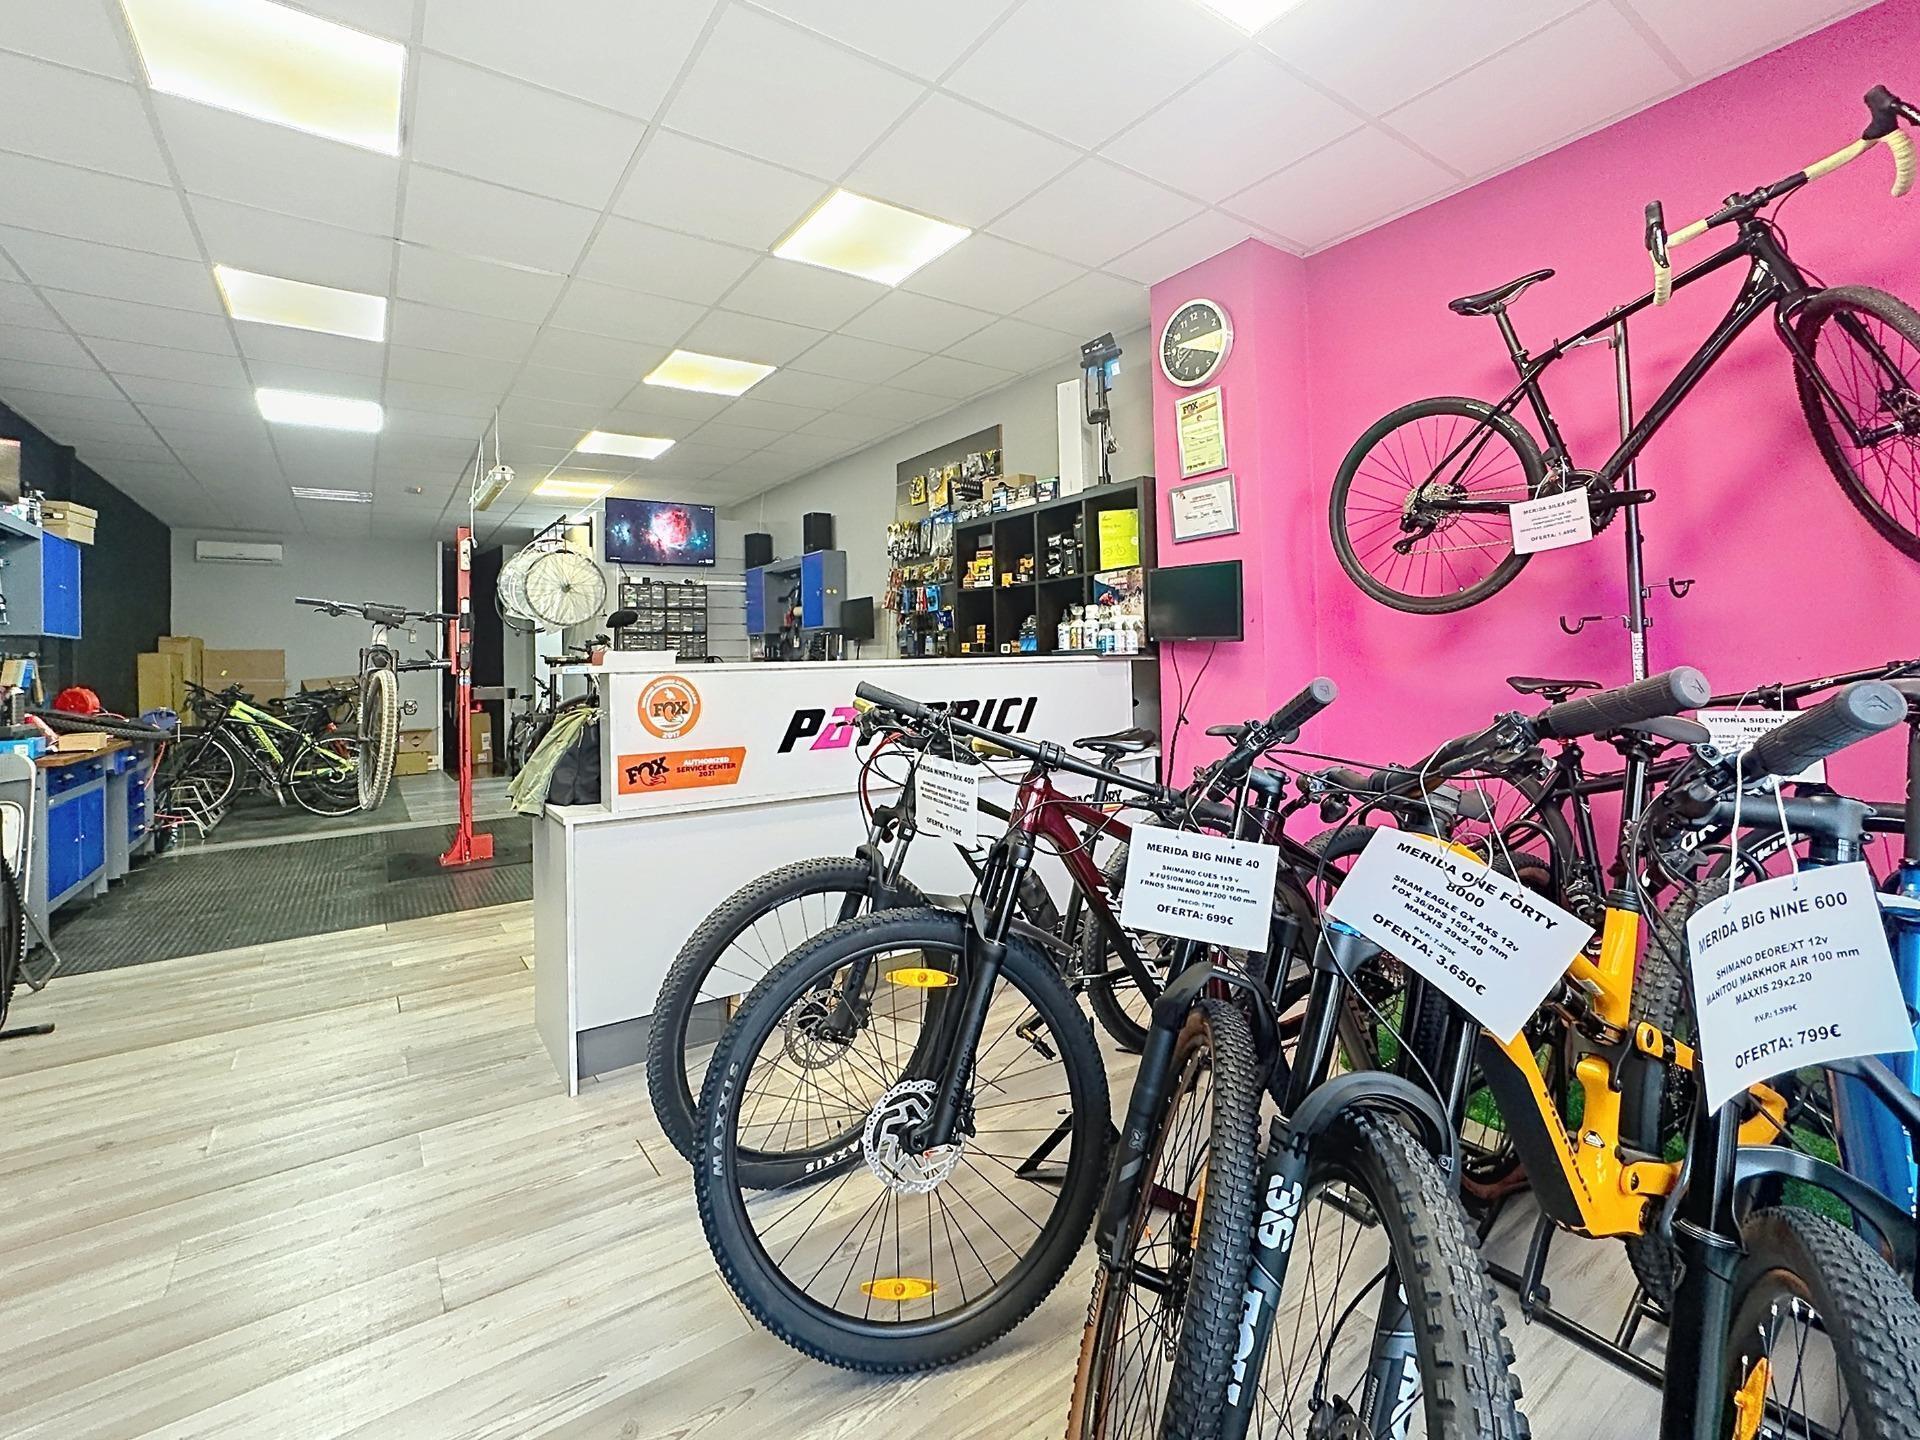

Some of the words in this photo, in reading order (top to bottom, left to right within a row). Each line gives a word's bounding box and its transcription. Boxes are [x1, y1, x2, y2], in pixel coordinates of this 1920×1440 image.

[1181, 320, 1188, 329] 11
[1190, 312, 1198, 321] 12
[1212, 318, 1216, 326] 2
[1173, 333, 1181, 341] 10
[1172, 348, 1176, 356] 9
[1176, 361, 1180, 369] 8
[1185, 367, 1189, 375] 7
[1207, 359, 1211, 367] 5
[1183, 401, 1198, 414] FOX
[1523, 506, 1547, 515] MERIDA
[653, 701, 689, 721] FOX
[626, 756, 670, 786] FOX
[677, 765, 707, 773] SERVICE
[708, 763, 736, 771] CENTER
[684, 757, 730, 766] AUTHORIZED
[919, 764, 933, 773] ERIDA
[1147, 843, 1189, 858] MERIDA
[1192, 851, 1212, 861] BIG
[1215, 854, 1242, 866] NINE
[1246, 859, 1260, 869] 40
[1162, 865, 1196, 876] SHIMANO
[1198, 871, 1218, 880] CUES
[1167, 885, 1200, 895] SHIMANO
[1202, 890, 1227, 900] MT200
[1186, 878, 1205, 887] MIGO
[1207, 882, 1220, 890] AIR
[1397, 842, 1457, 875] MERIDA
[1461, 872, 1498, 895] ONE
[1500, 892, 1559, 930] FORTY
[1446, 882, 1485, 908] 8000
[1157, 904, 1204, 920] OFERTA:
[1207, 914, 1234, 925] 699€
[1392, 885, 1412, 899] FOX
[1413, 896, 1448, 920] 36/DPS
[1451, 918, 1488, 946] 150/140
[1489, 943, 1508, 960] mm
[1394, 875, 1423, 894] SRAM
[1425, 890, 1458, 912] EAGLE
[1460, 911, 1475, 924] GX
[1476, 921, 1499, 939] AXS
[1501, 937, 1520, 953] 12v
[1698, 922, 1739, 954] MERIDA
[1741, 911, 1765, 930] BIG
[1770, 899, 1810, 920] NINE
[1815, 892, 1848, 910] 600
[1404, 903, 1444, 930] MAXXIS
[1444, 927, 1484, 956] 29x2.40
[1372, 913, 1433, 958] OFERTA:
[1436, 955, 1487, 996] 3.650€
[1716, 956, 1753, 980] SHIMANO
[1808, 936, 1829, 946] 12v
[1706, 980, 1738, 1006] MANITOU
[1739, 962, 1787, 986] MARKHOR
[1790, 956, 1809, 969] AIR
[1812, 951, 1833, 963] 100
[1837, 948, 1860, 959] mm
[1735, 984, 1770, 1005] MAXXIS
[1771, 972, 1812, 991] 29x2.20
[1735, 1037, 1794, 1069] OFERTA:
[1797, 1024, 1842, 1045] 799€
[712, 1062, 738, 1177] MAXXIS
[804, 1140, 861, 1173] AXXIS
[1257, 1174, 1302, 1253] 36
